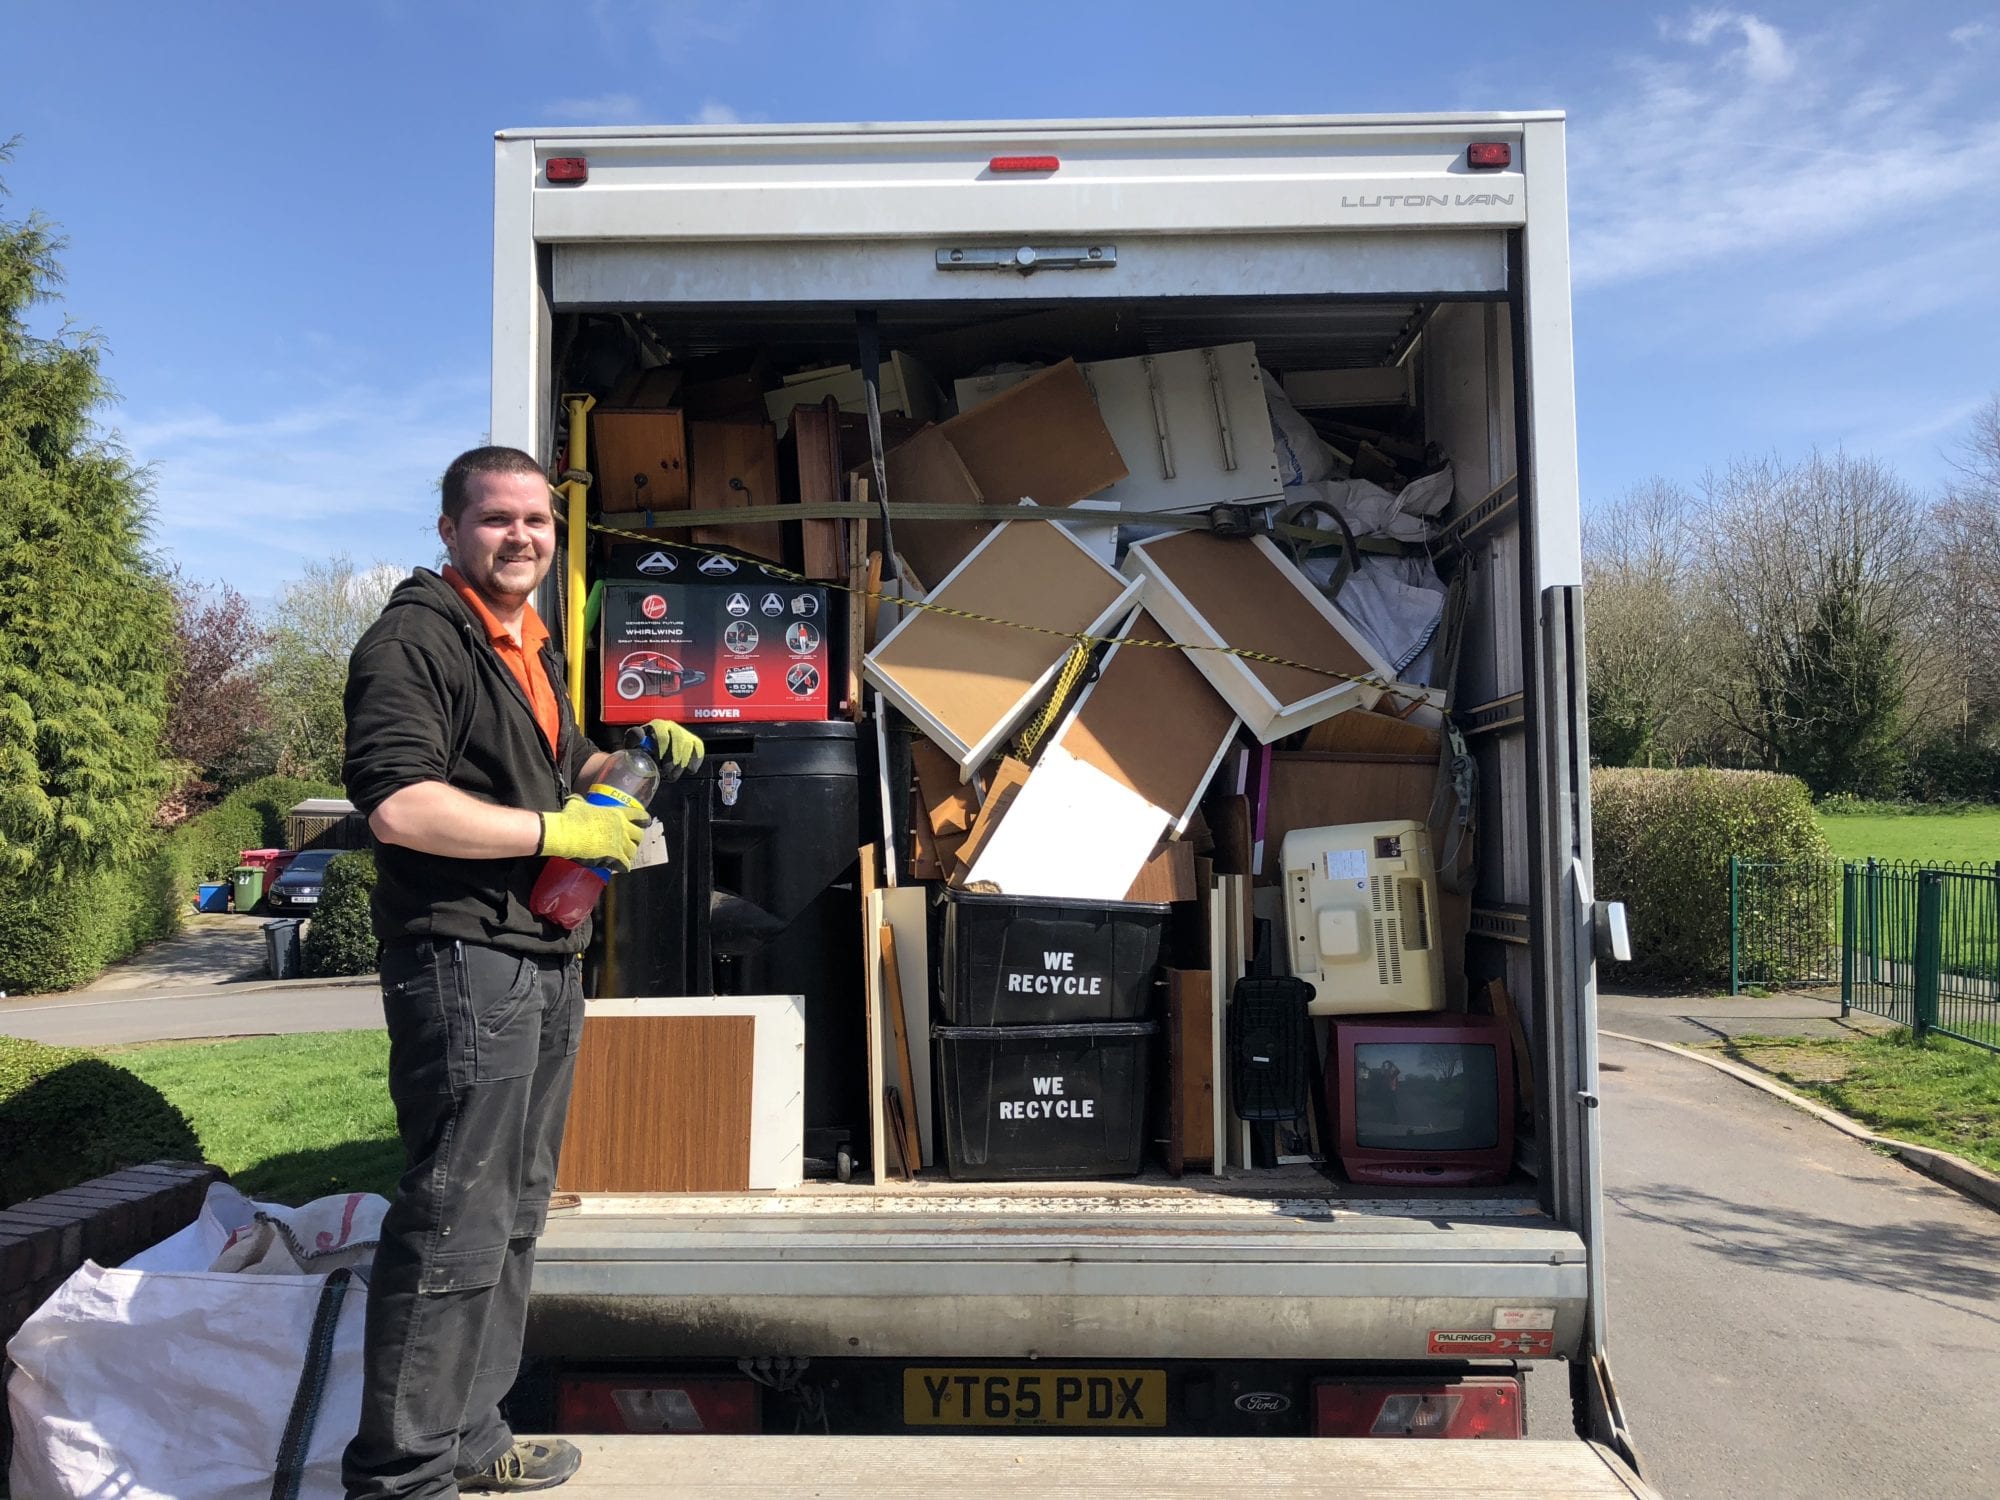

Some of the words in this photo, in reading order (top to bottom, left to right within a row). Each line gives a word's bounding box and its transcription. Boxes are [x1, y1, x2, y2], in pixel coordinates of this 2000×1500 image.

[1341, 194, 1449, 208] LUTON
[1454, 193, 1515, 206] VAN
[694, 709, 741, 718] HOOVER
[238, 875, 250, 885] 27
[1043, 952, 1074, 971] WE
[1008, 973, 1102, 996] RECYCLE
[1032, 1077, 1064, 1096] WE
[999, 1099, 1095, 1120] RECYCLE
[924, 1376, 1041, 1418] YT65
[1056, 1377, 1144, 1419] PDX
[1247, 1396, 1279, 1410] Ford
